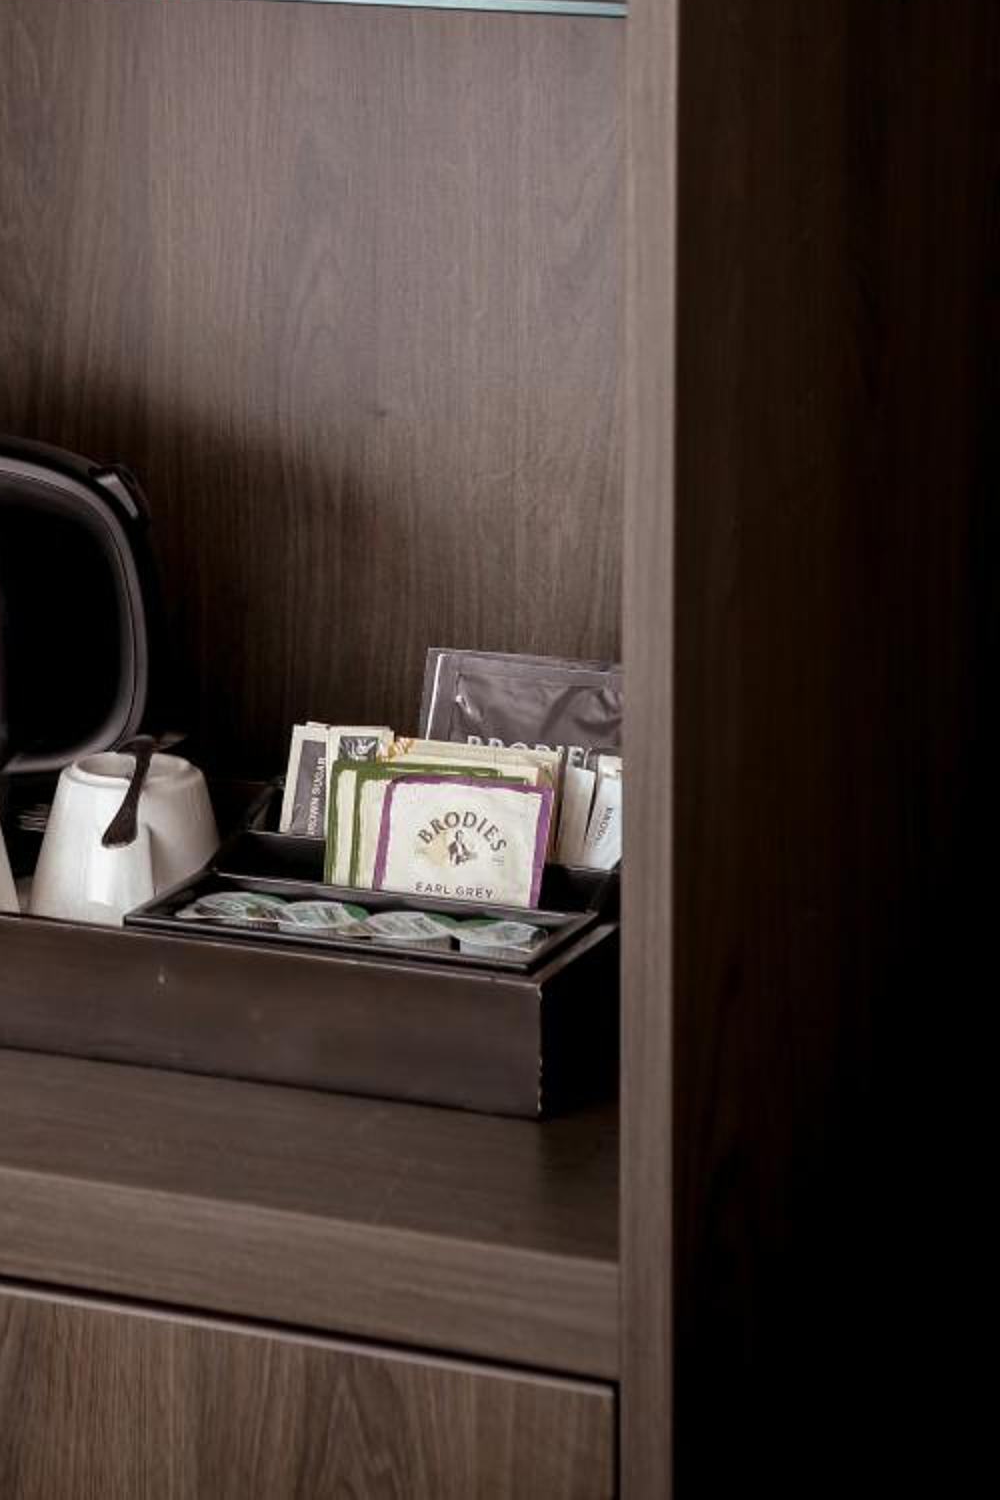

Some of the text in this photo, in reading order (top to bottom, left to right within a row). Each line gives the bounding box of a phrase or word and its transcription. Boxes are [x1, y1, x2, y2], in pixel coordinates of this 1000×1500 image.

[418, 811, 507, 852] BRODIES
[415, 882, 493, 899] EARL GREY
